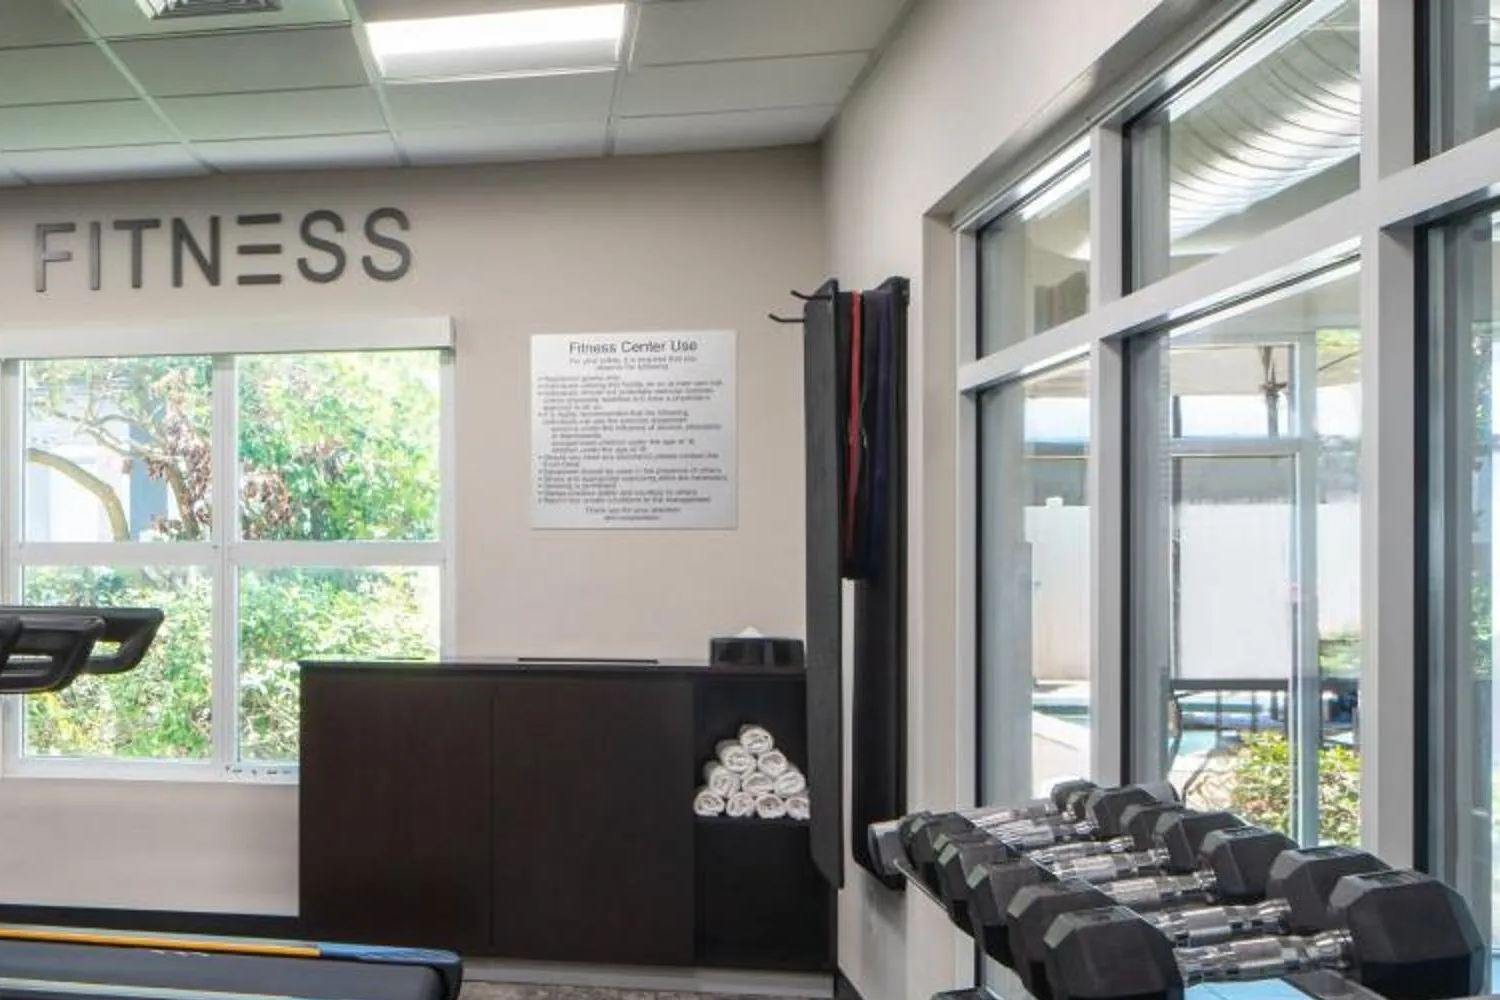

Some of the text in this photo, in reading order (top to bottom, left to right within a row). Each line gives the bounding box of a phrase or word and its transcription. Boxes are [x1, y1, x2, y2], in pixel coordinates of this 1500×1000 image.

[36, 207, 411, 292] FITNESS
[569, 339, 698, 354] Fitness Center Use
